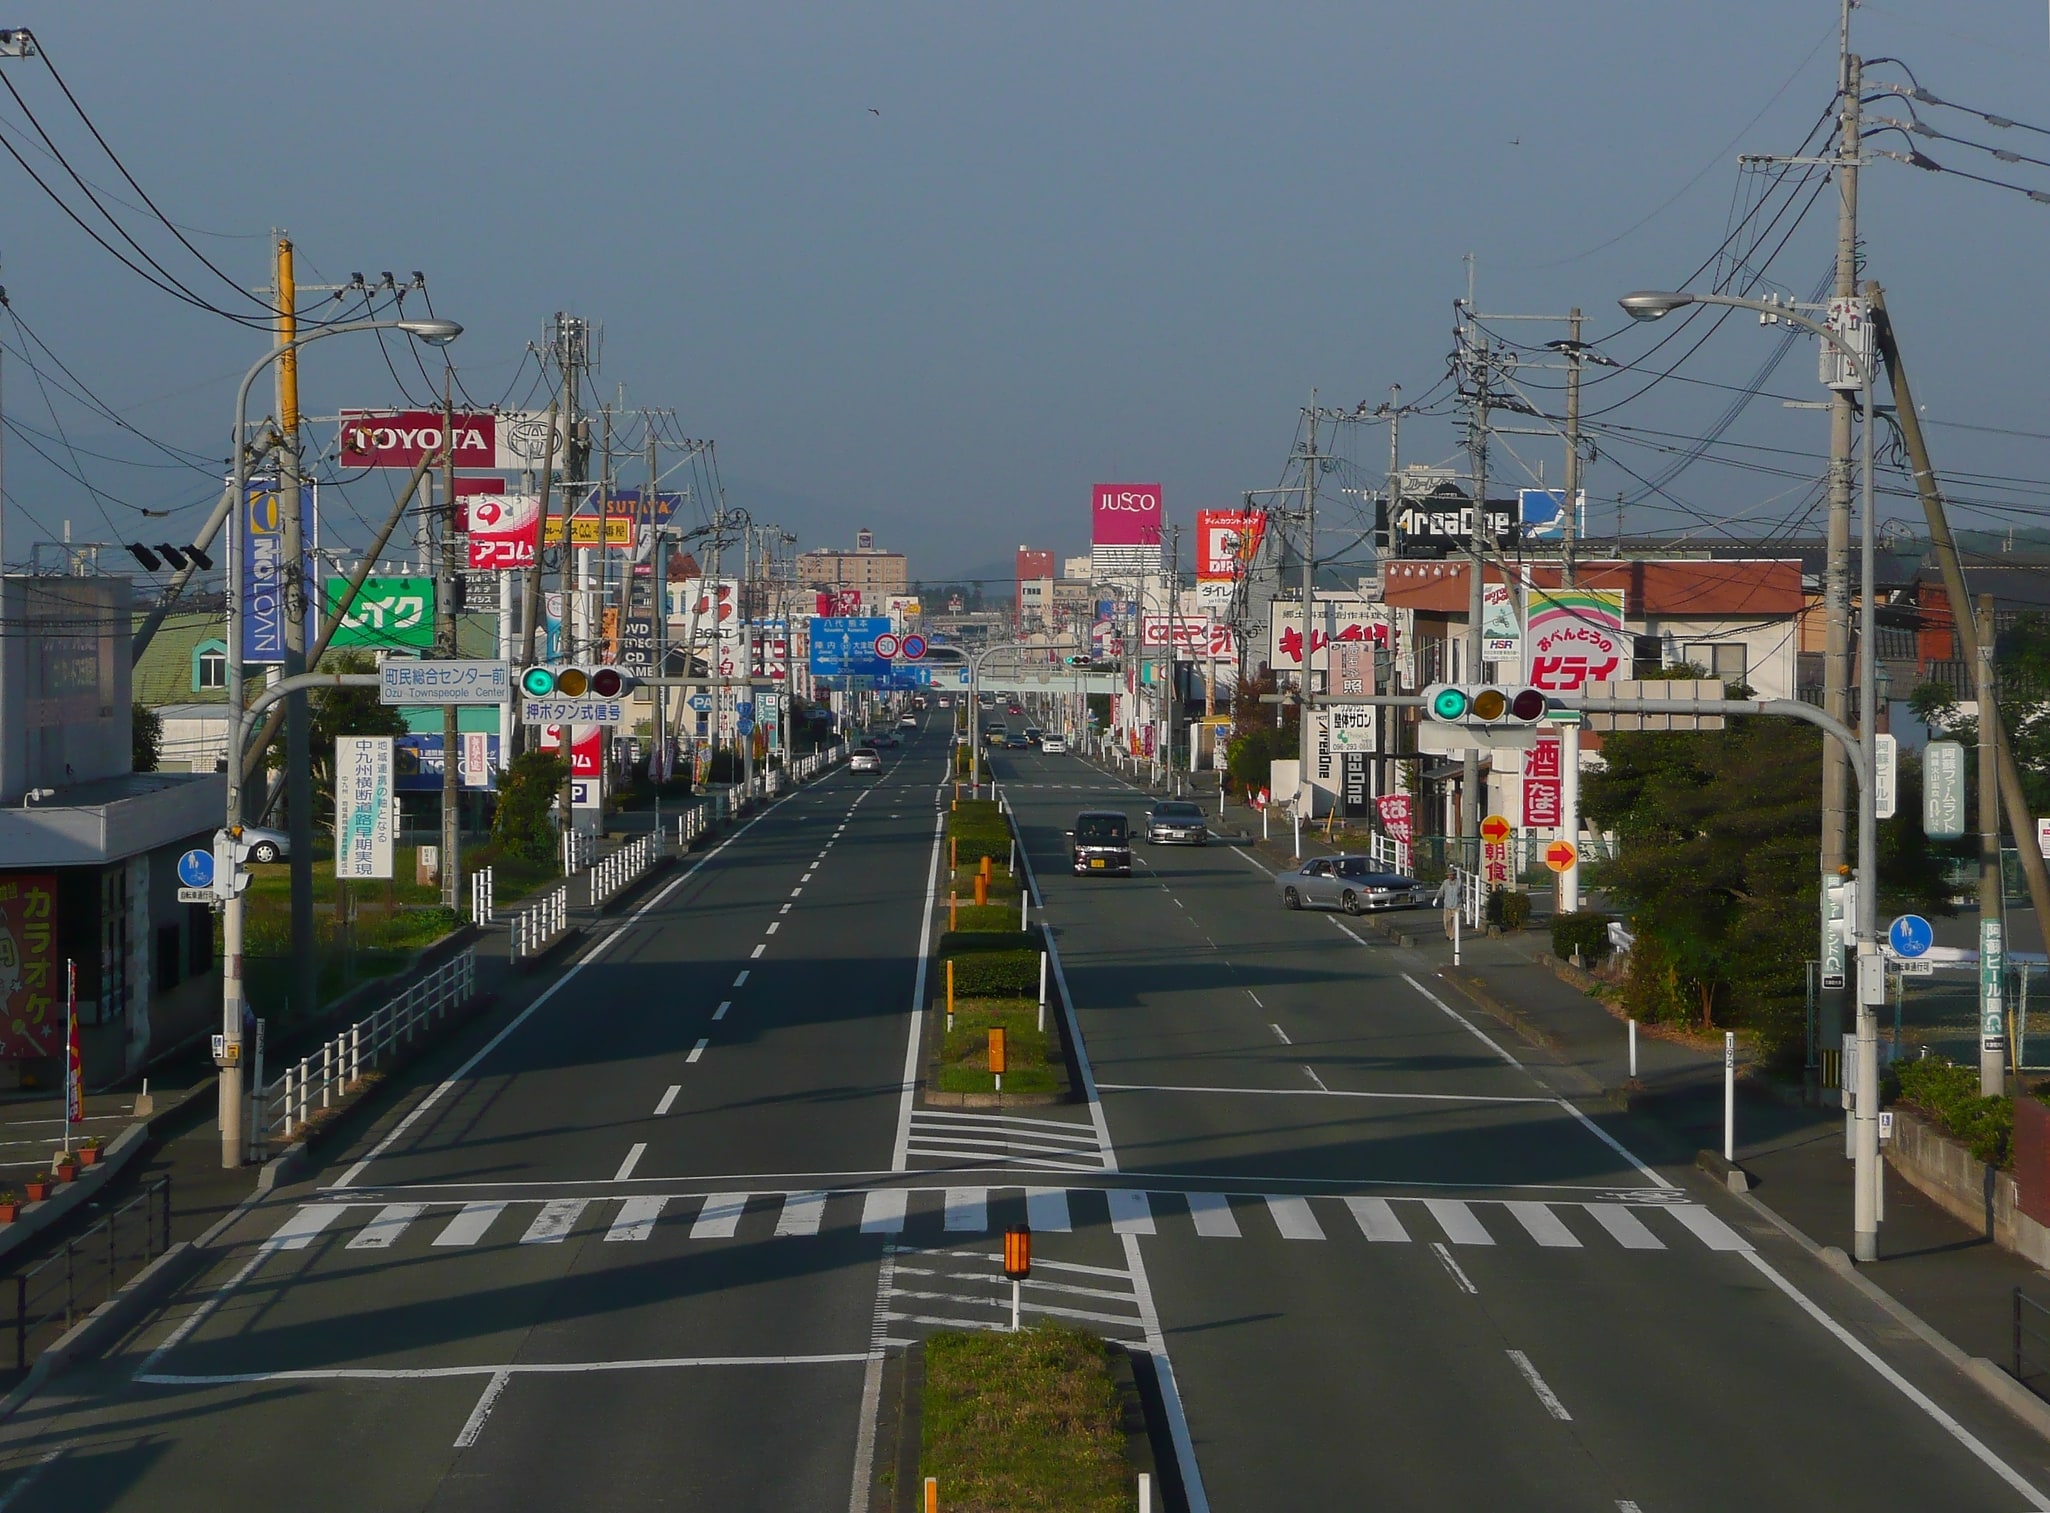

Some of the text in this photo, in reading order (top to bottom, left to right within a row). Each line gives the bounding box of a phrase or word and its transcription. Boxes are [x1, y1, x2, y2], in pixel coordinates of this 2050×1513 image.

[349, 428, 488, 449] TOYOTA
[1100, 492, 1155, 512] JUSCO
[475, 541, 534, 561] アコム
[340, 596, 423, 629] レイク
[880, 641, 893, 651] 50
[1490, 640, 1513, 649] HSR
[1536, 627, 1613, 653] おべんとうの
[626, 653, 645, 662] CD
[385, 667, 505, 685] 町民総合センター前
[1530, 657, 1619, 690] ヒライ
[385, 687, 505, 698] Ozu Townspeople Center
[526, 703, 621, 721] 押ボタン式信号
[1334, 713, 1371, 728] 整体サロン
[1524, 740, 1560, 777] 酒
[1347, 752, 1366, 804] eaOne
[1942, 748, 1956, 833] 阿蘇ファームランド
[355, 740, 373, 876] 中九州横断道路早期実現
[1528, 782, 1555, 823] たばこ
[1484, 842, 1508, 881] 朝食
[22, 885, 51, 1024] カラオケ
[1891, 961, 1930, 972] 自転車通行可
[1986, 923, 2002, 1013] 阿蘇ビール園
